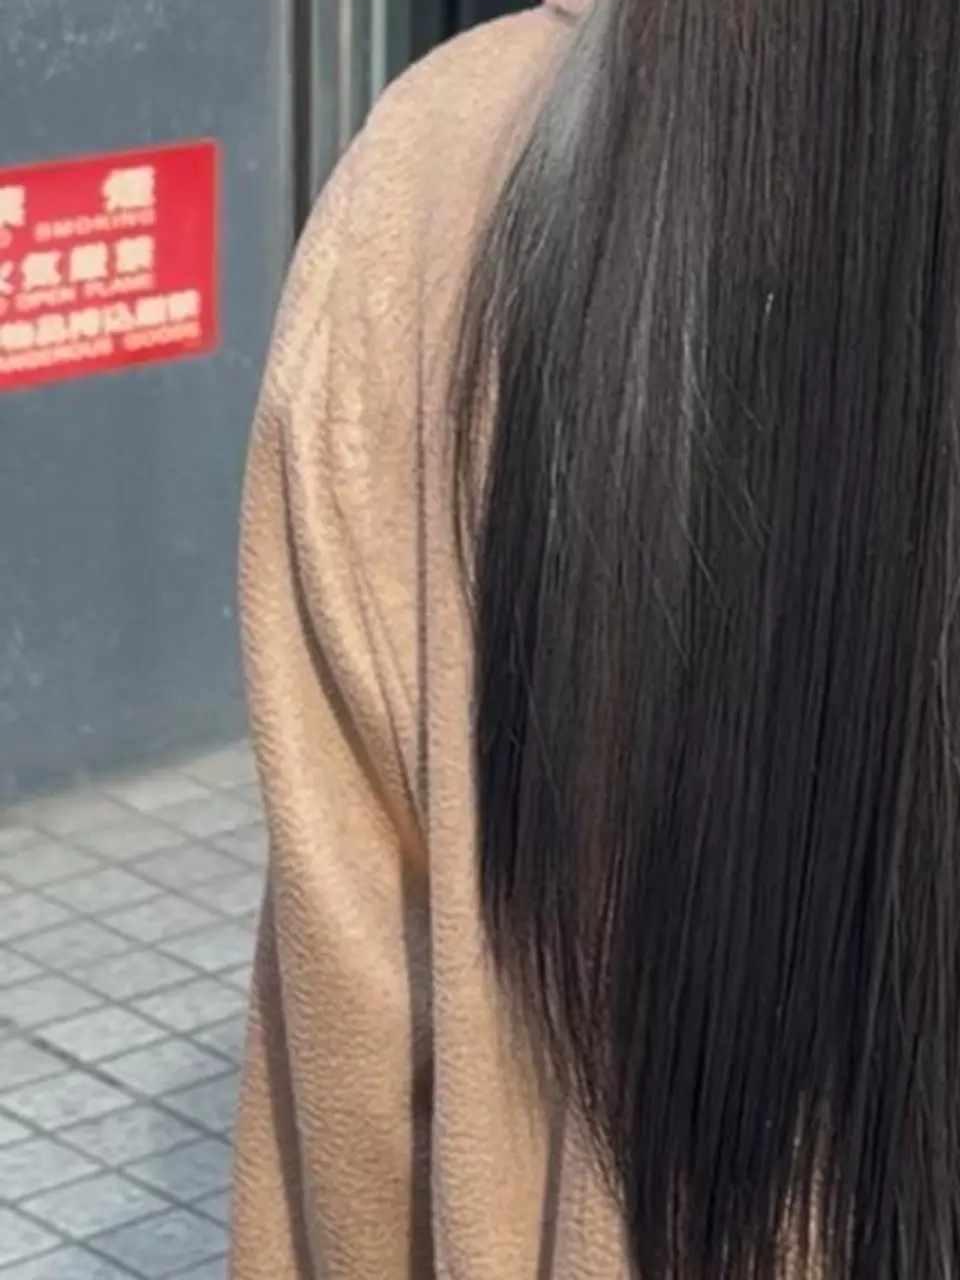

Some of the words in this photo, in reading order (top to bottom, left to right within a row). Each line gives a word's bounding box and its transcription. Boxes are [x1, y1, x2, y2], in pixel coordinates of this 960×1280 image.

[33, 207, 157, 242] SMOKING
[15, 286, 77, 312] OPEN
[83, 271, 156, 299] FLAME
[122, 320, 200, 352] GOODS
